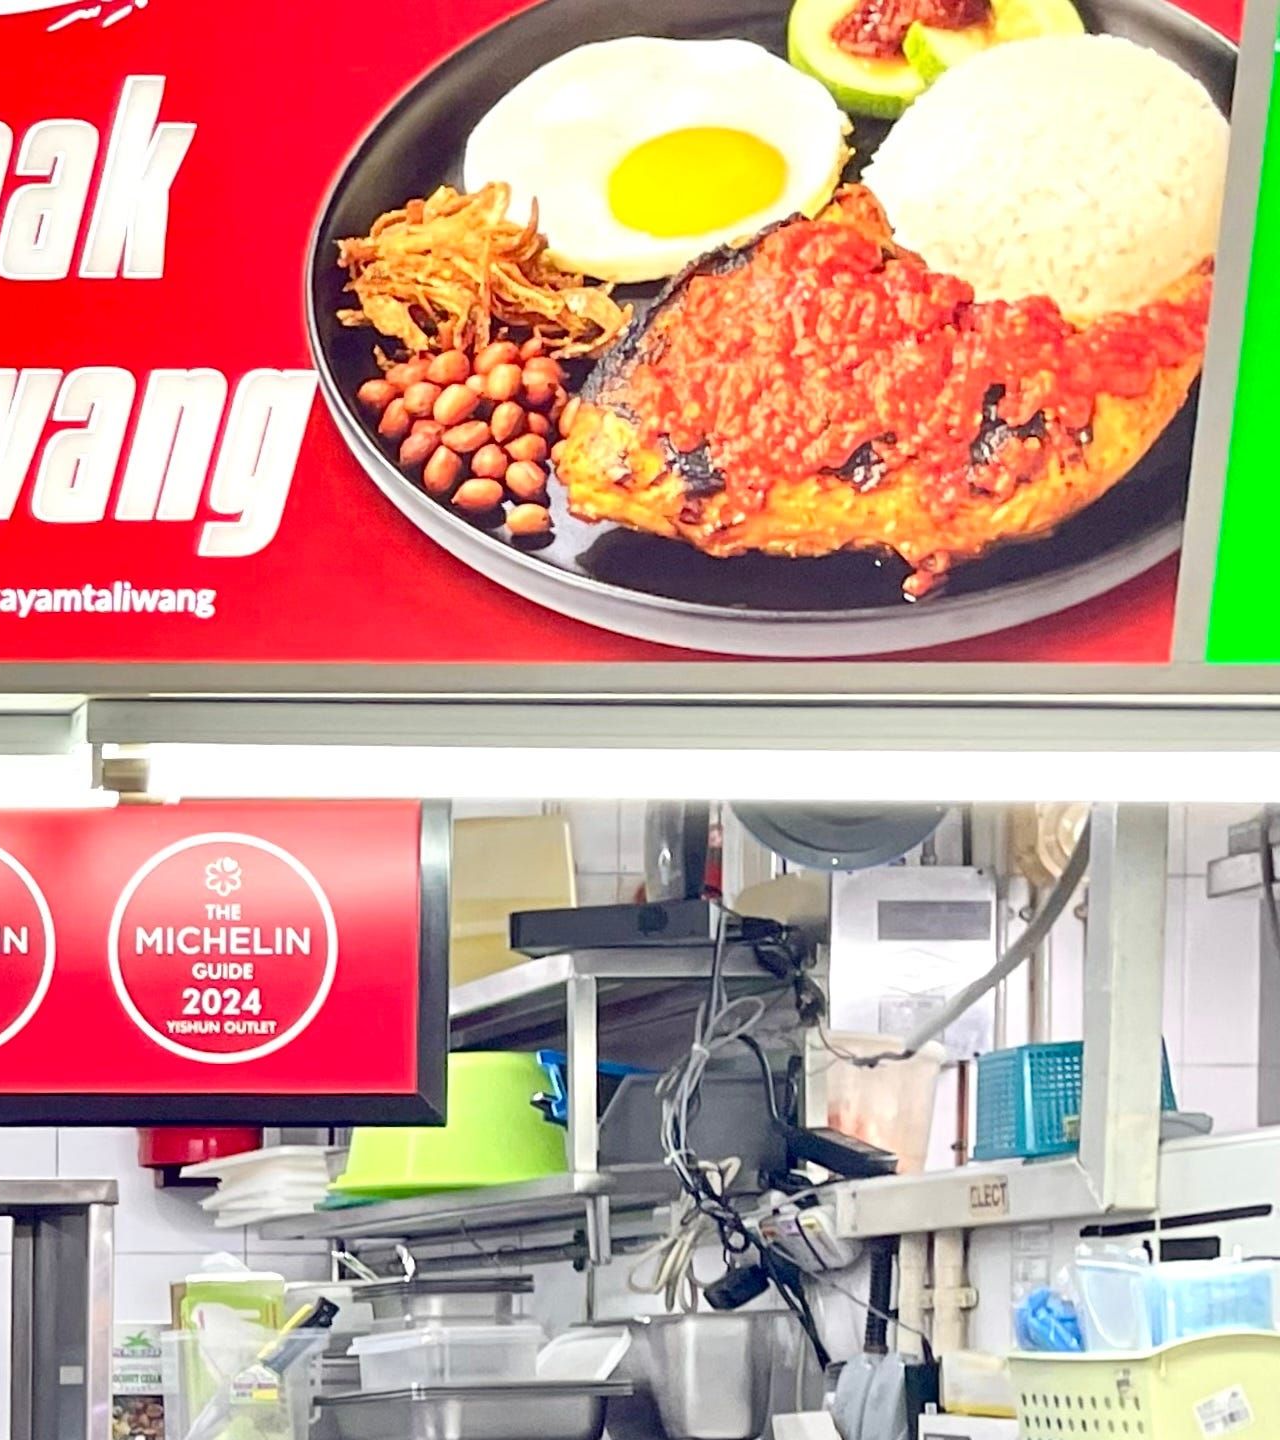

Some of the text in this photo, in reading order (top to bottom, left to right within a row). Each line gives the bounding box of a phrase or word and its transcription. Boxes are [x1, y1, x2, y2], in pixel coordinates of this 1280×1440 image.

[205, 903, 242, 921] THE
[135, 927, 312, 957] MICHELIN
[192, 962, 254, 982] GUIDE
[181, 988, 263, 1016] 2024
[166, 1021, 277, 1036] YISHUN OUTLET
